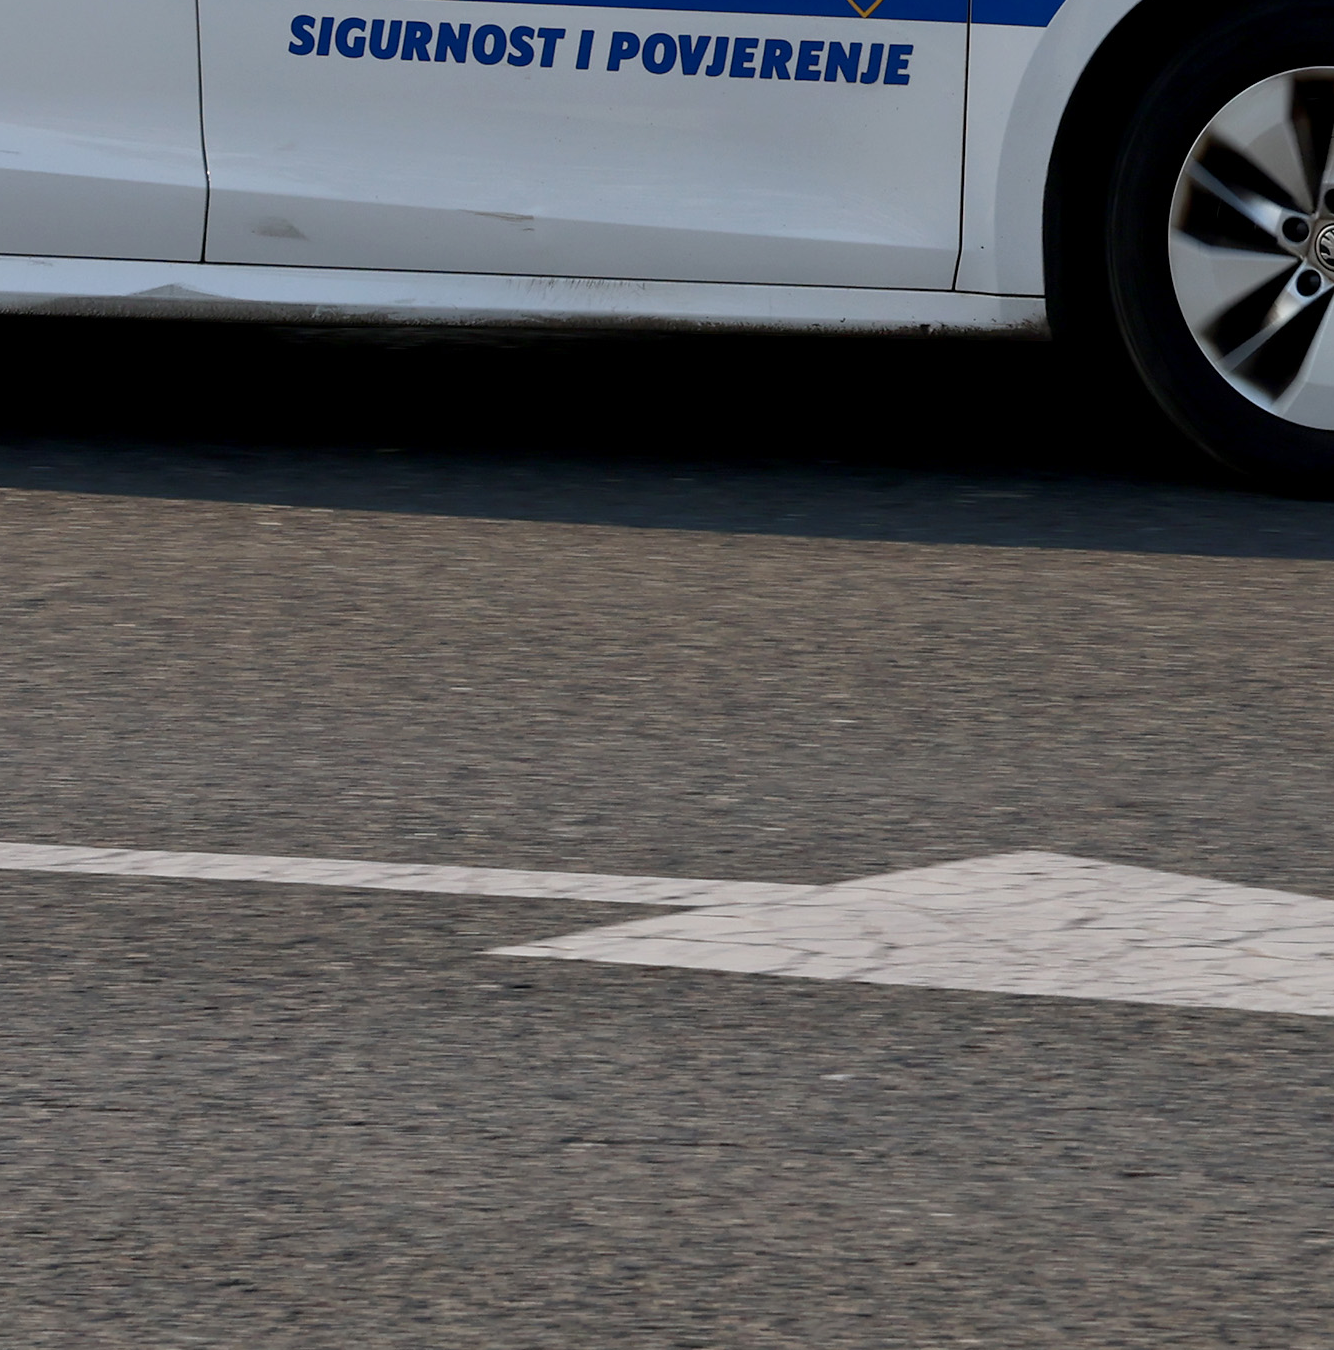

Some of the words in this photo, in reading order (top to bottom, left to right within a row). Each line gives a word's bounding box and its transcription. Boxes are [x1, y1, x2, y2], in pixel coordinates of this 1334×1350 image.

[287, 14, 566, 69] SIGURNOST
[575, 29, 595, 70] I
[606, 30, 914, 86] POVJERENJE
